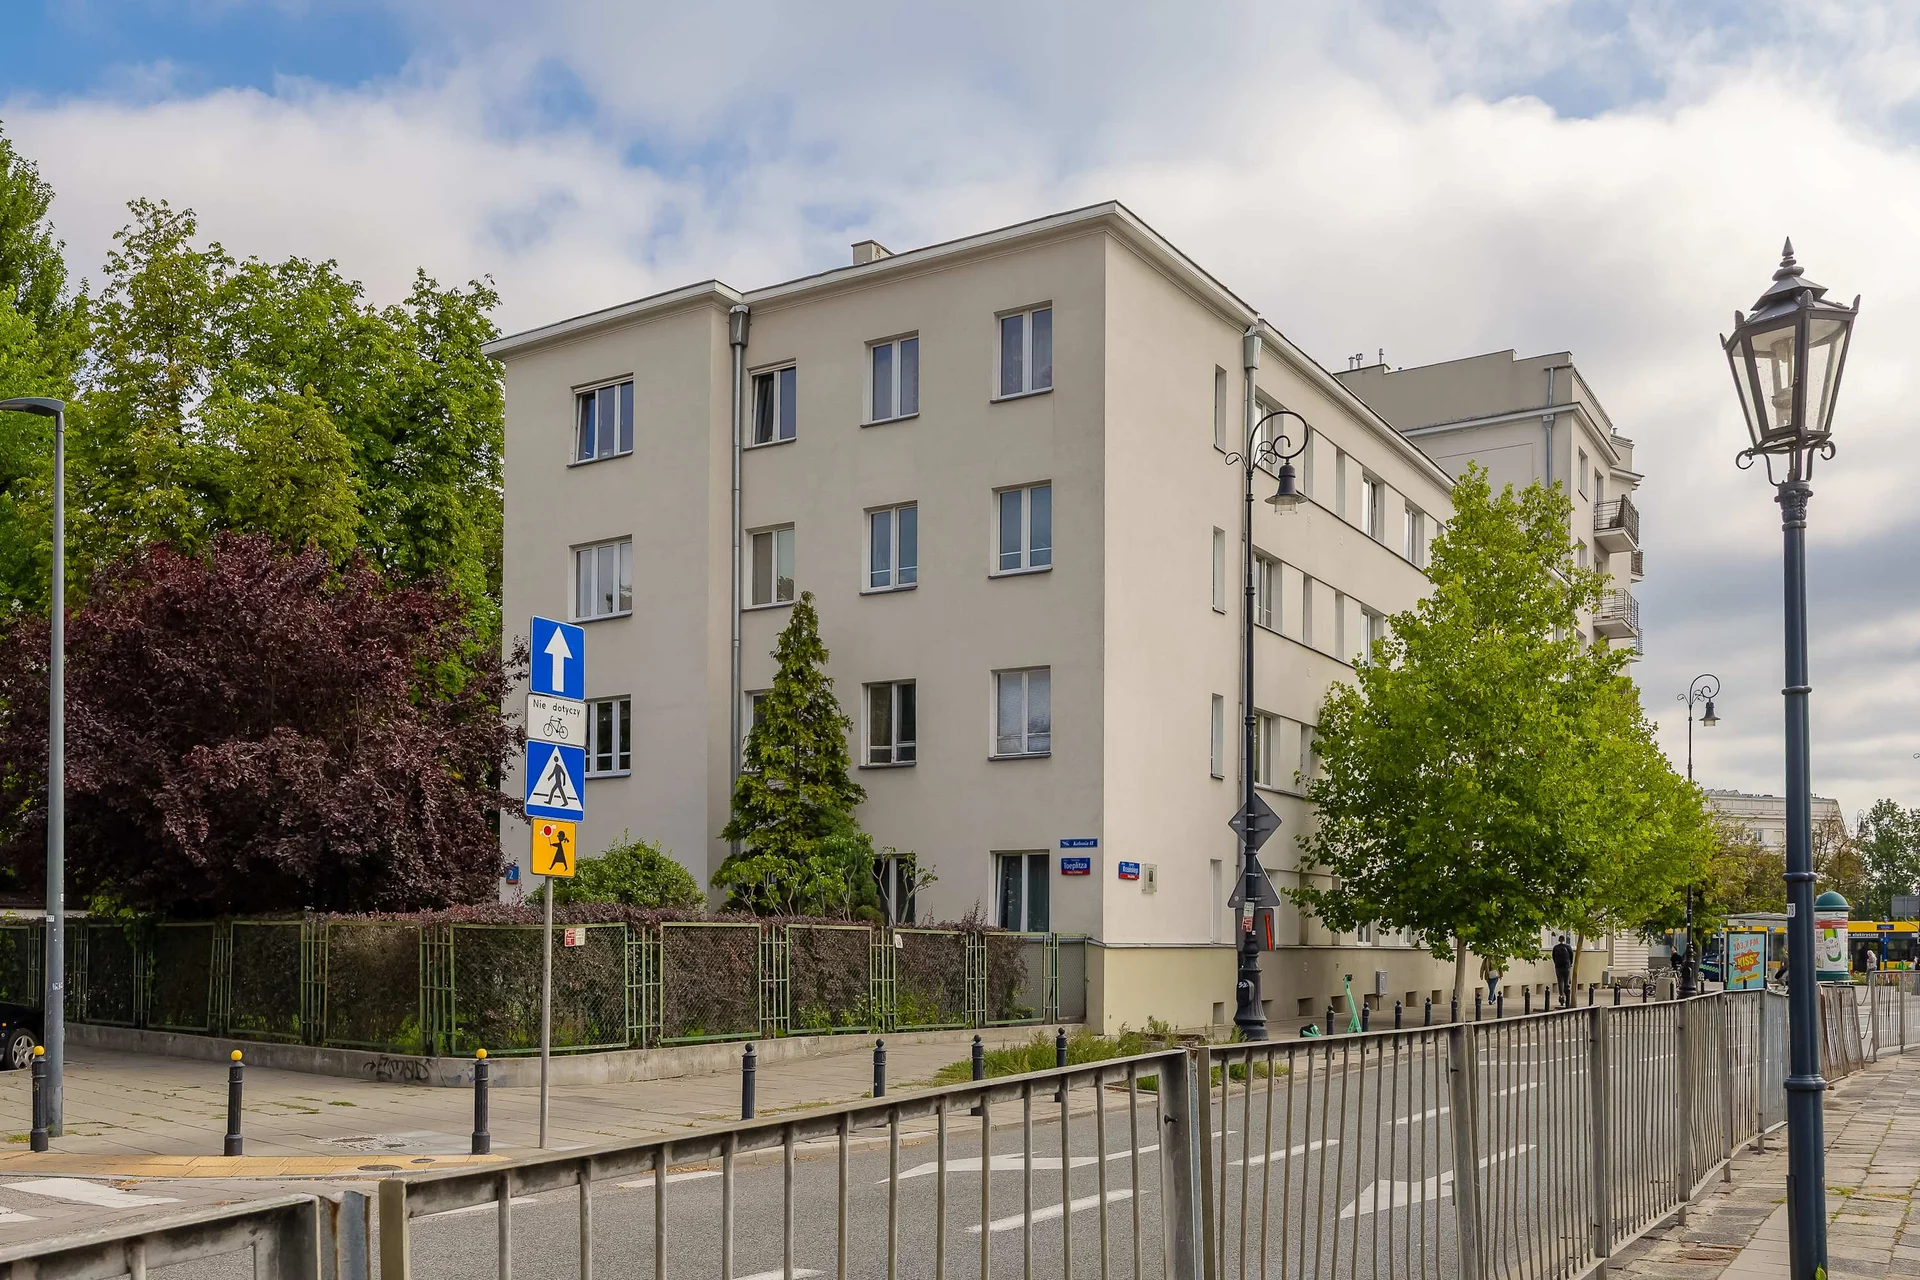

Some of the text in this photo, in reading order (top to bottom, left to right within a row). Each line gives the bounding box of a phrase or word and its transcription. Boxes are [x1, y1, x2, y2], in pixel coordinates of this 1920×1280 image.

[532, 699, 581, 718] Nie dotyczy
[1063, 862, 1088, 870] Toeplitza
[1737, 954, 1754, 968] KISS
